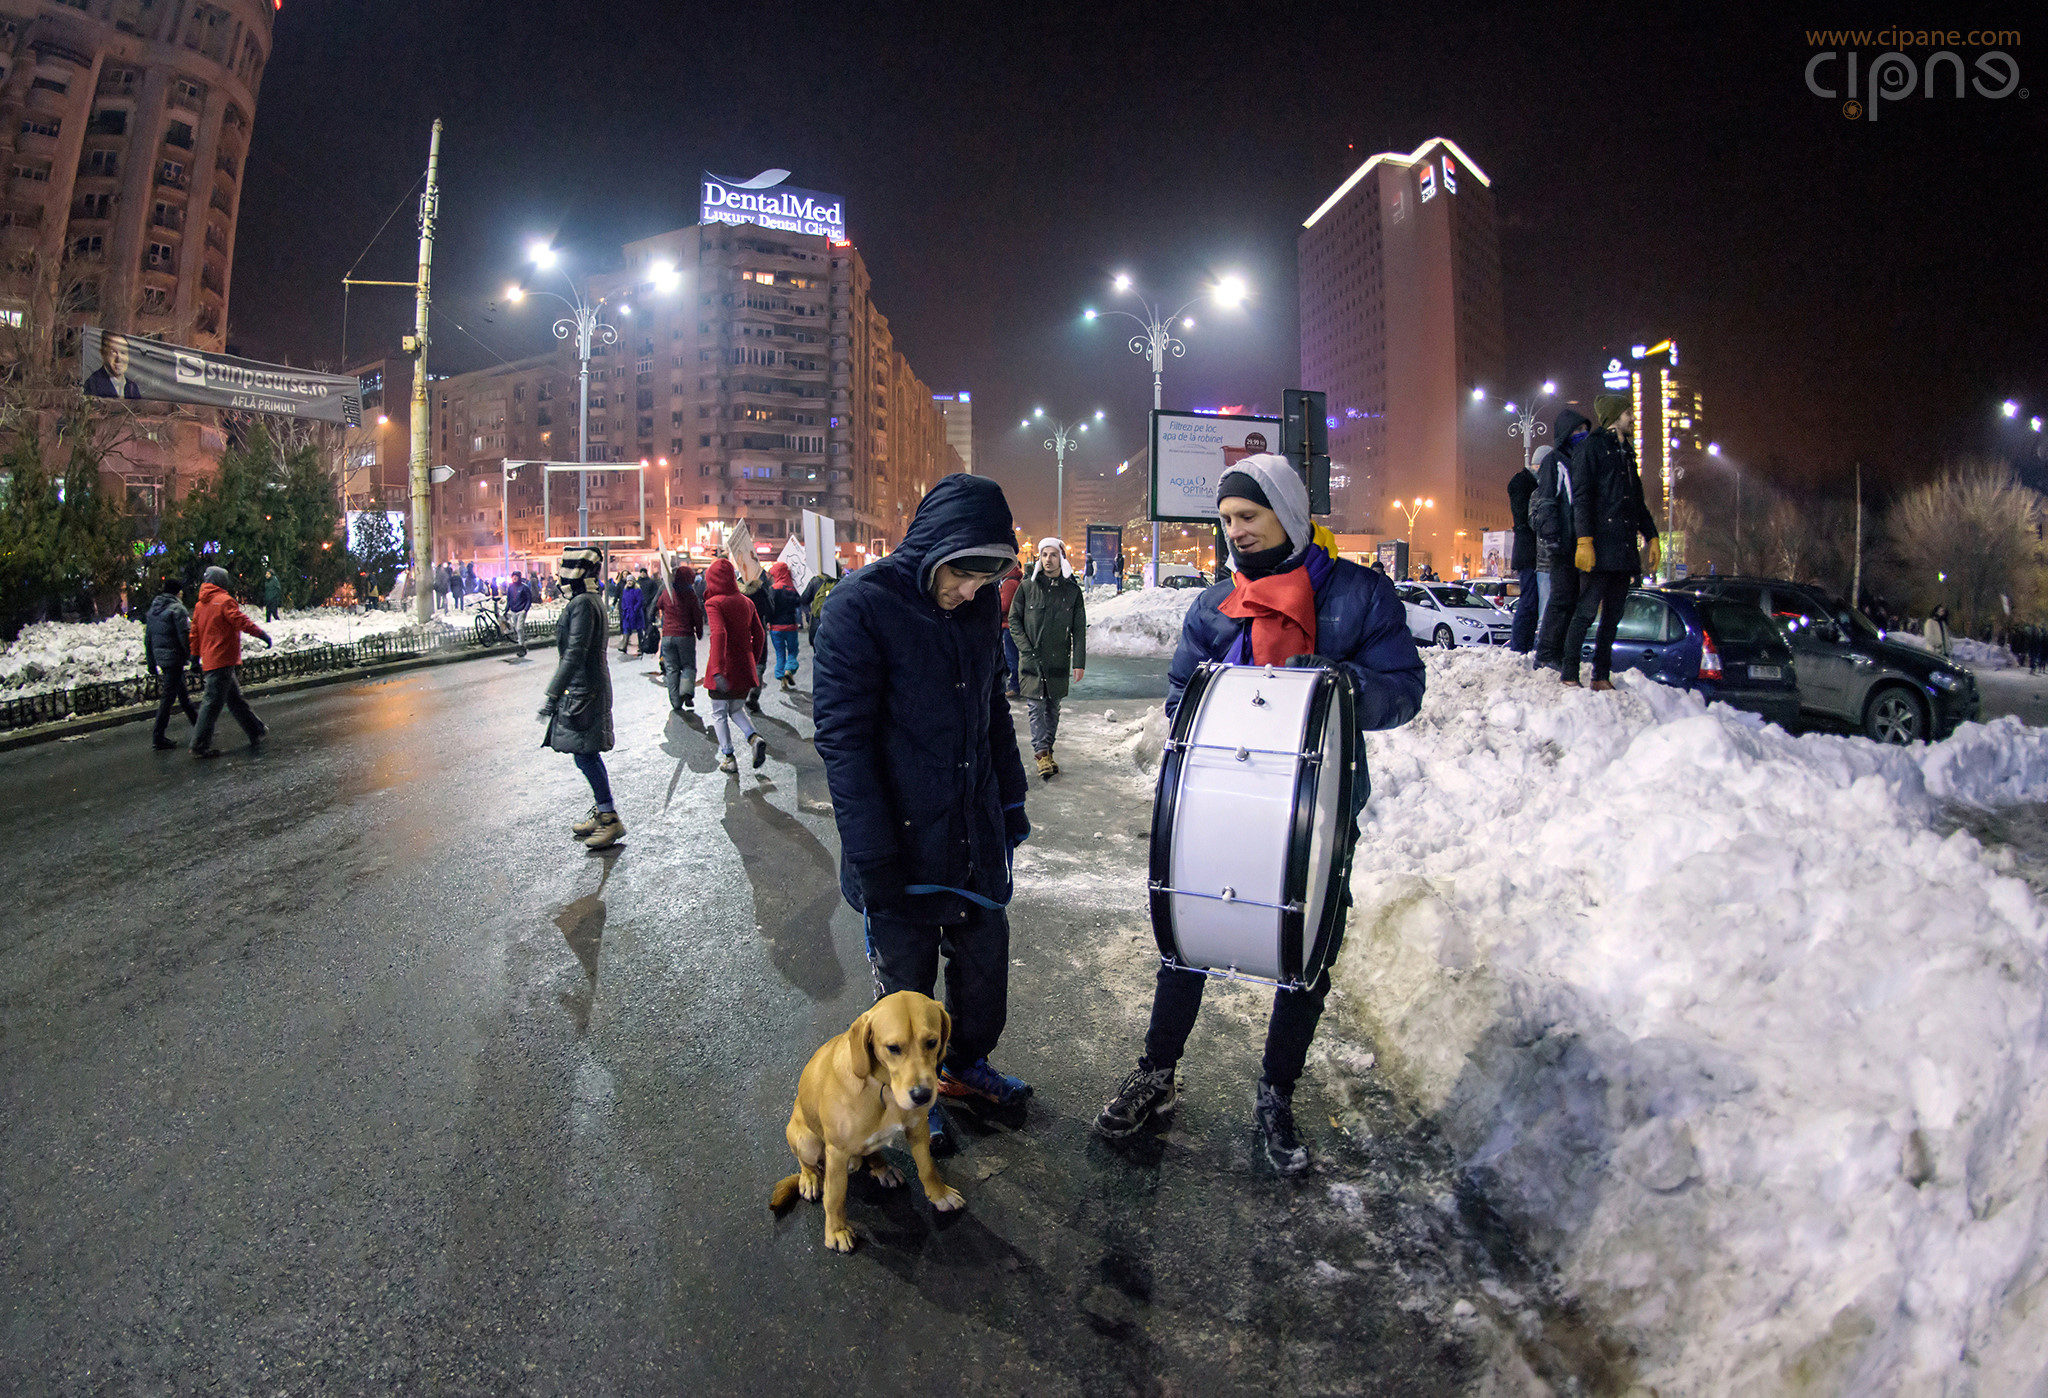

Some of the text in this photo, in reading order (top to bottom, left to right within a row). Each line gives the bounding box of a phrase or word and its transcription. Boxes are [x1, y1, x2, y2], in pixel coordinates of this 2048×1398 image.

[703, 182, 842, 225] DentalMed
[704, 206, 842, 239] Luxury Dental Clinic
[206, 360, 328, 398] stiripesurse.ro
[231, 395, 296, 414] AFLĂ PRIMUL!
[1194, 424, 1204, 433] pe
[1205, 423, 1217, 433] loc
[1162, 432, 1224, 444] apa de la robinet
[1169, 477, 1195, 487] AQUA
[1182, 486, 1214, 494] OPTIMA
